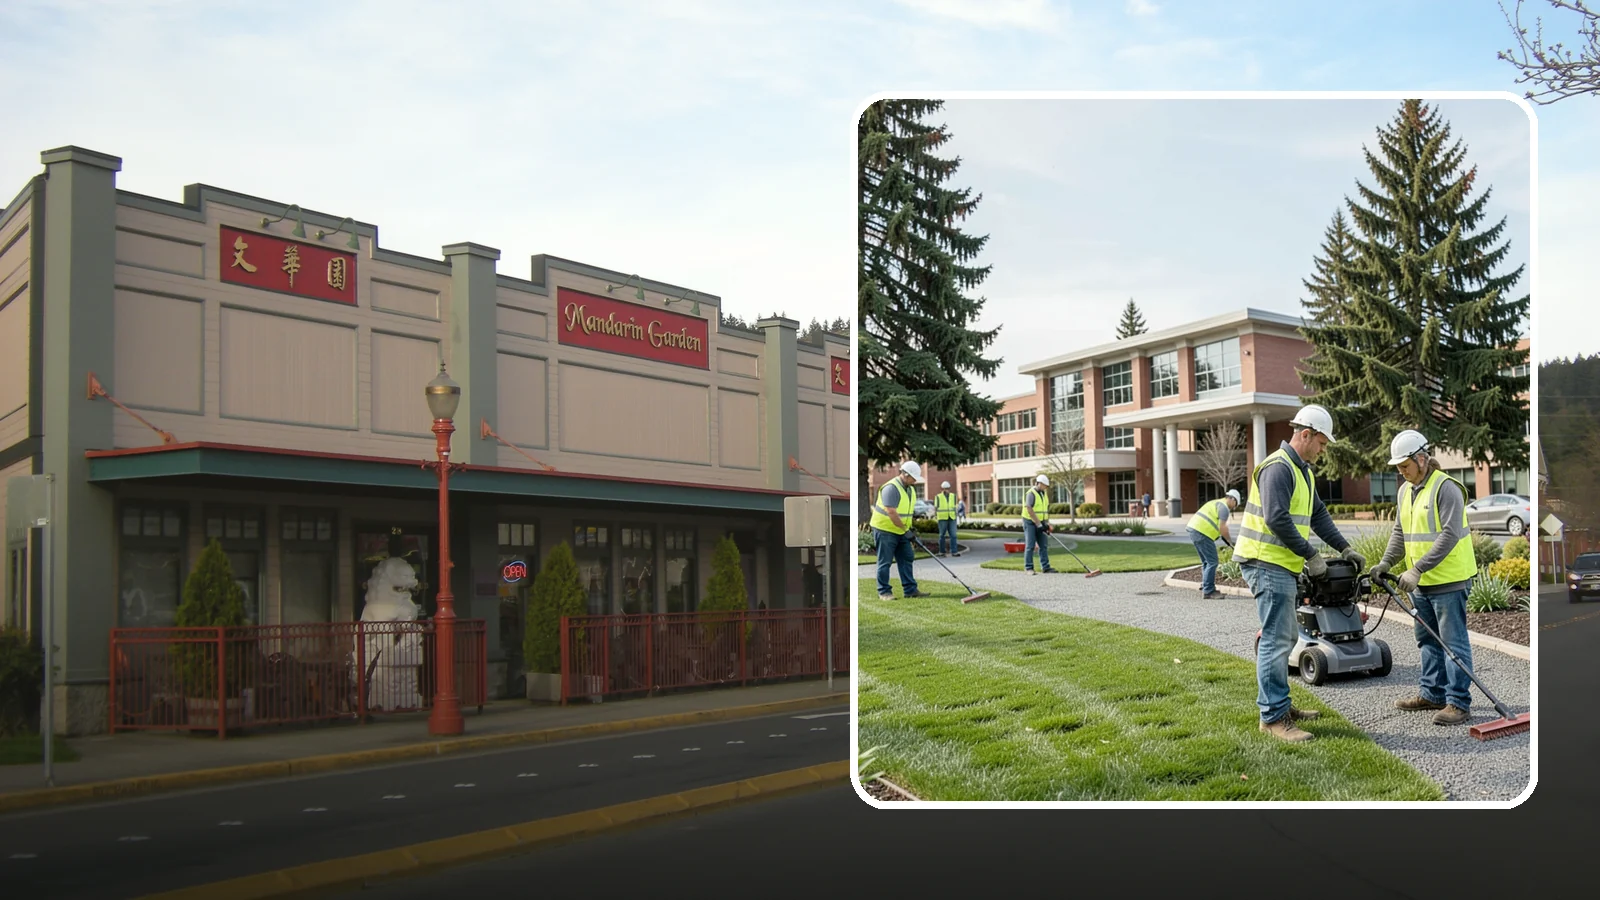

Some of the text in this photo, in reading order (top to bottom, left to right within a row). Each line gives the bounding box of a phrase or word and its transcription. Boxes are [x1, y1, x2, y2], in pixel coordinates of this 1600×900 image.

[564, 301, 702, 352] Mandarin Garden
[503, 565, 527, 578] OPEN
